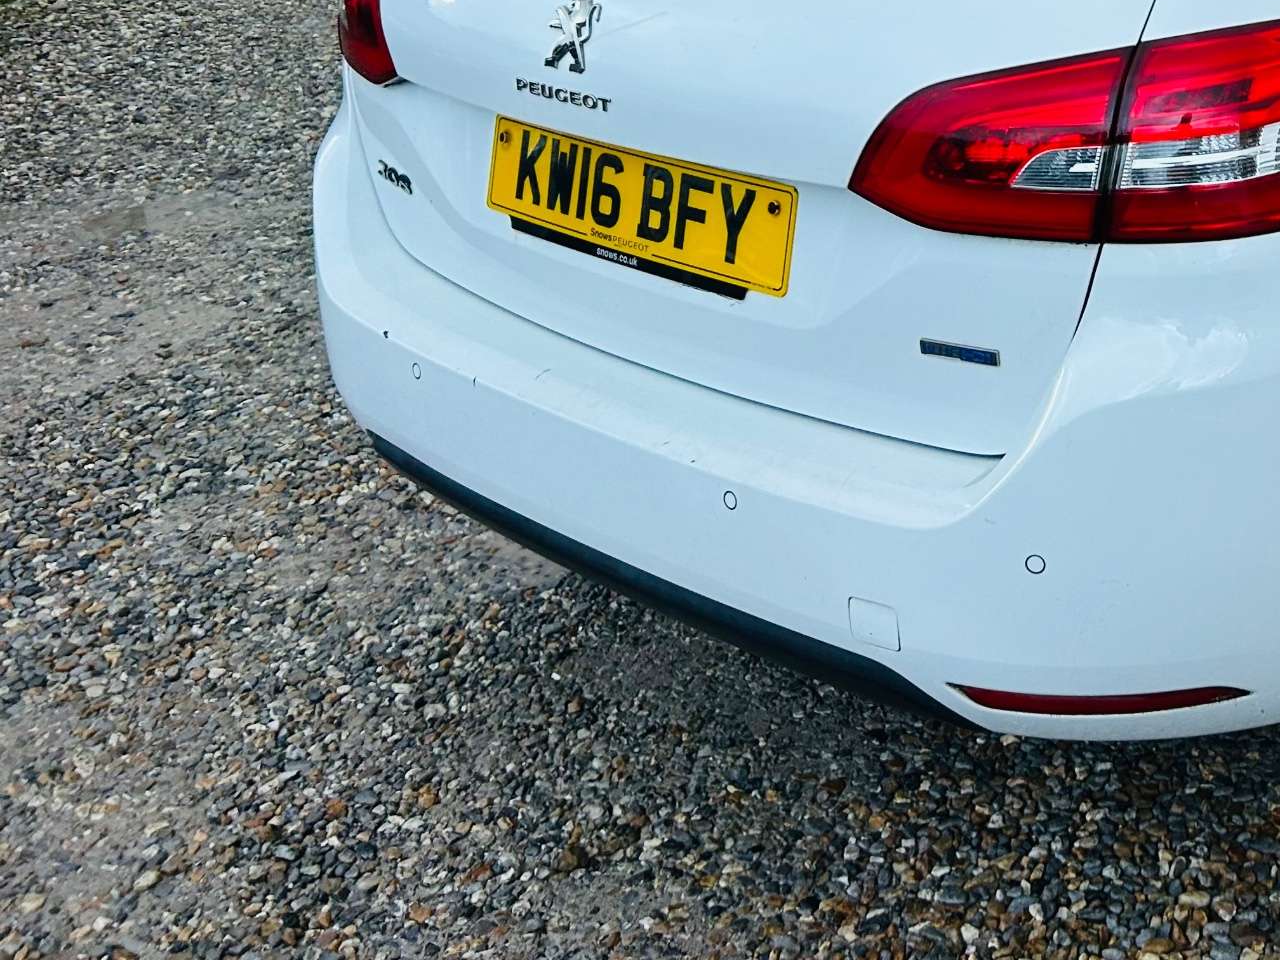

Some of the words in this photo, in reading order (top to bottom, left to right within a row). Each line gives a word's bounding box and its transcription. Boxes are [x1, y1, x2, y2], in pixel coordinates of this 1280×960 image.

[516, 78, 612, 112] PEUGEOT
[515, 130, 625, 229] KW16
[636, 163, 757, 265] BFY
[596, 247, 638, 266] snows.co.uk
